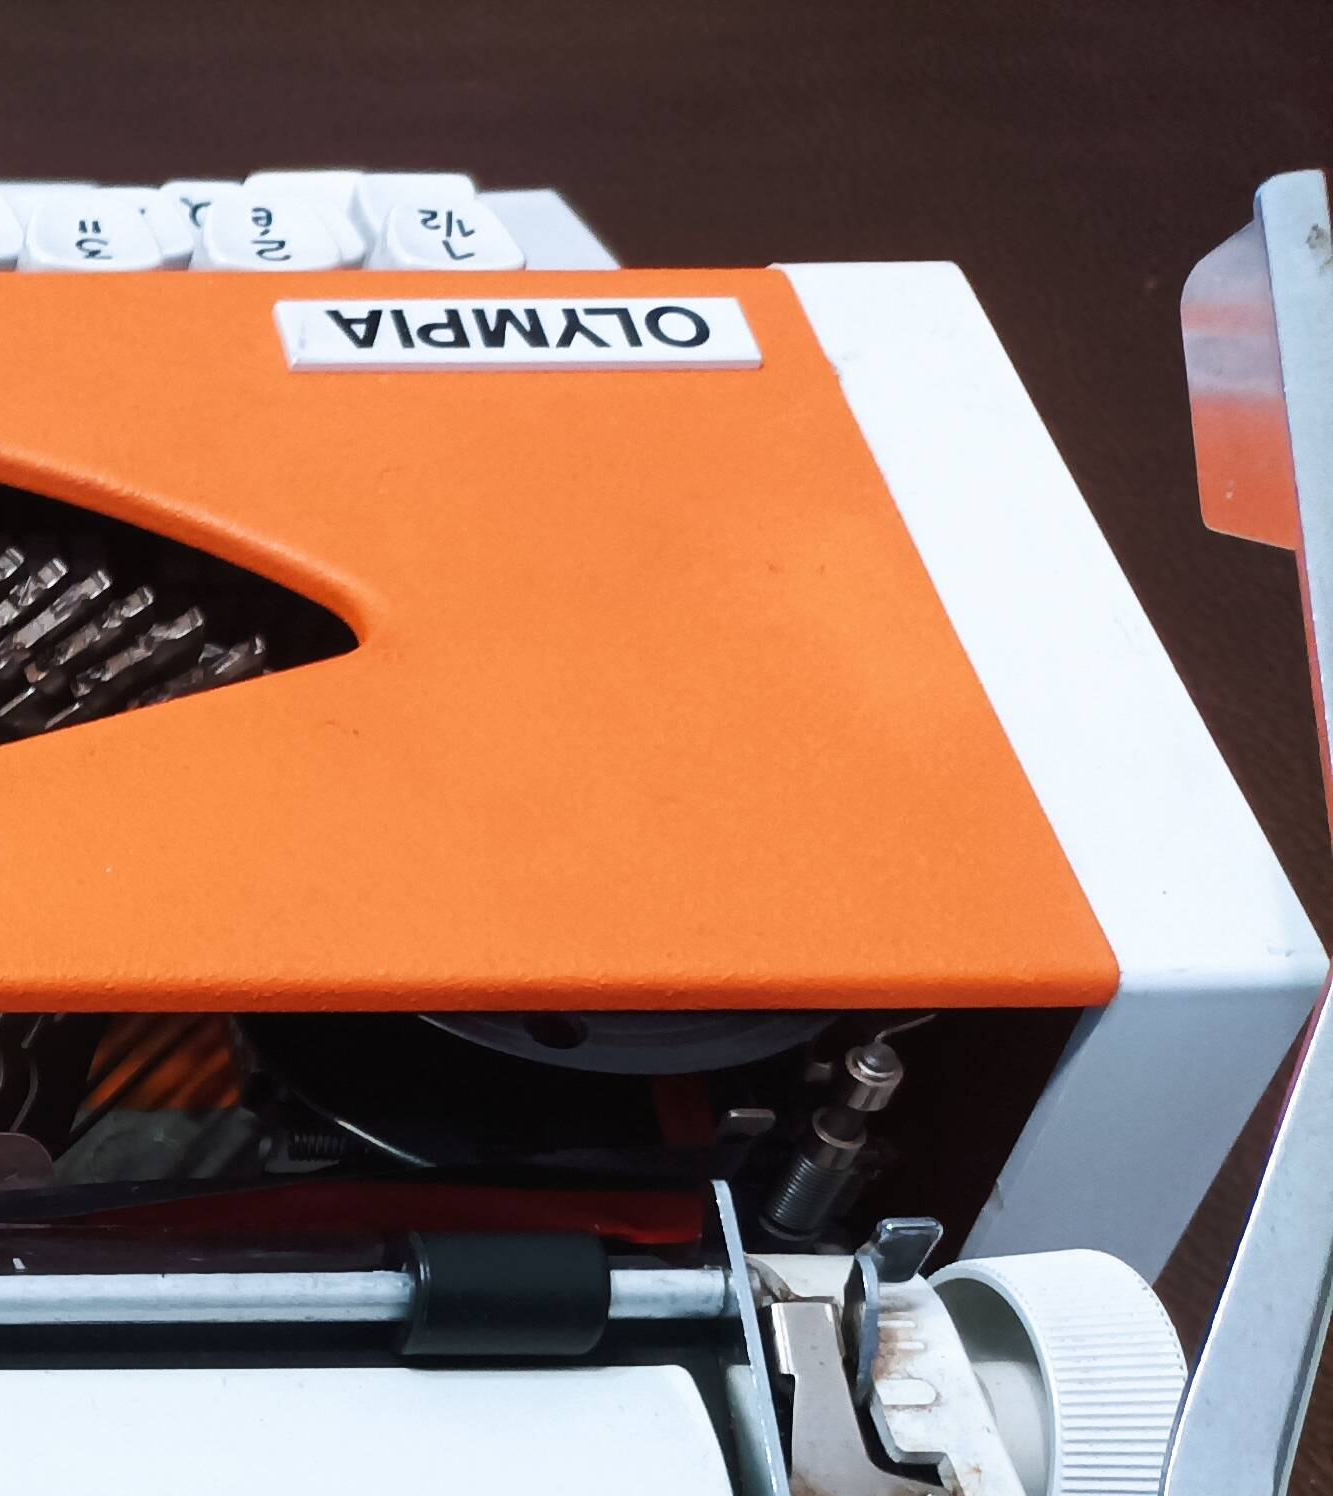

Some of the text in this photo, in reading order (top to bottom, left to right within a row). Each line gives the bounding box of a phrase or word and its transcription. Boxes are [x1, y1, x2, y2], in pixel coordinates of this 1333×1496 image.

[75, 238, 113, 260] 3
[251, 239, 292, 261] 2
[324, 304, 712, 350] OLYMPIA
